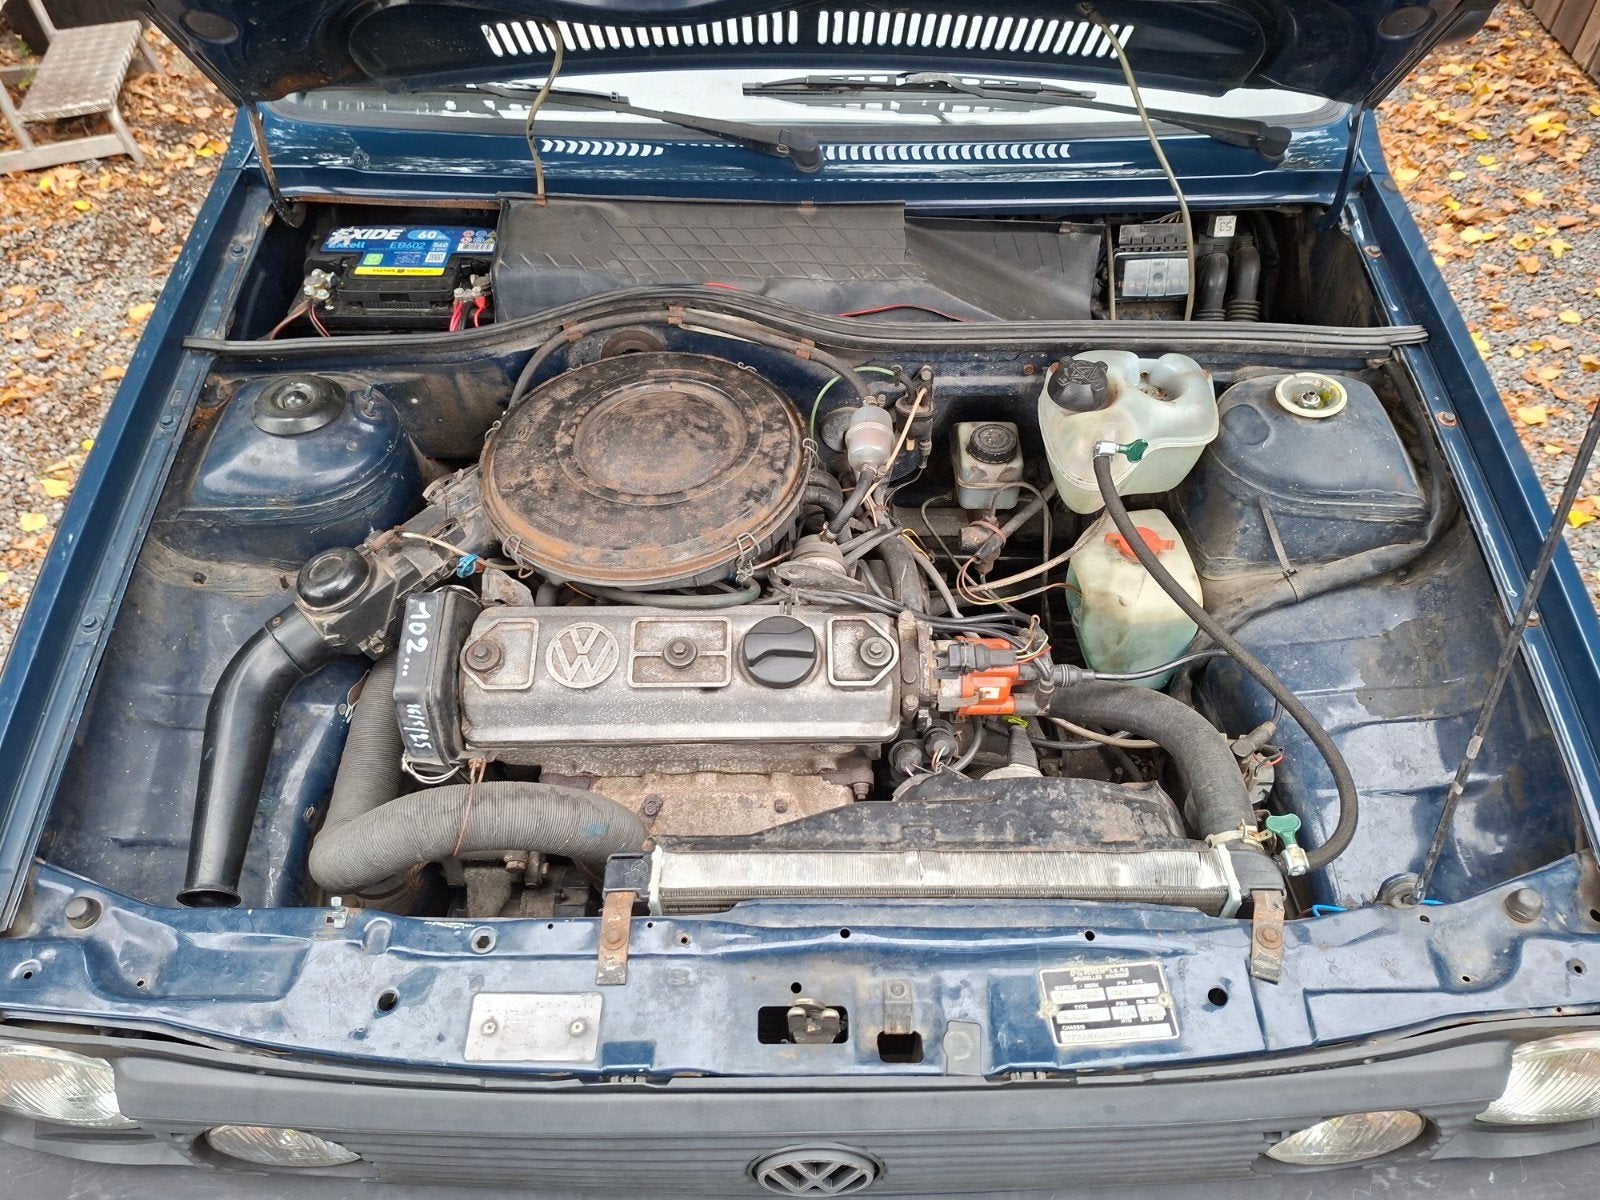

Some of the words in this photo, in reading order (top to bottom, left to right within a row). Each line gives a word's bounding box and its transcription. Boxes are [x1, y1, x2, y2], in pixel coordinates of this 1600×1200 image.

[332, 228, 403, 240] EXIDE
[418, 231, 437, 240] 60
[549, 623, 617, 686] VW
[760, 1154, 871, 1196] VW
